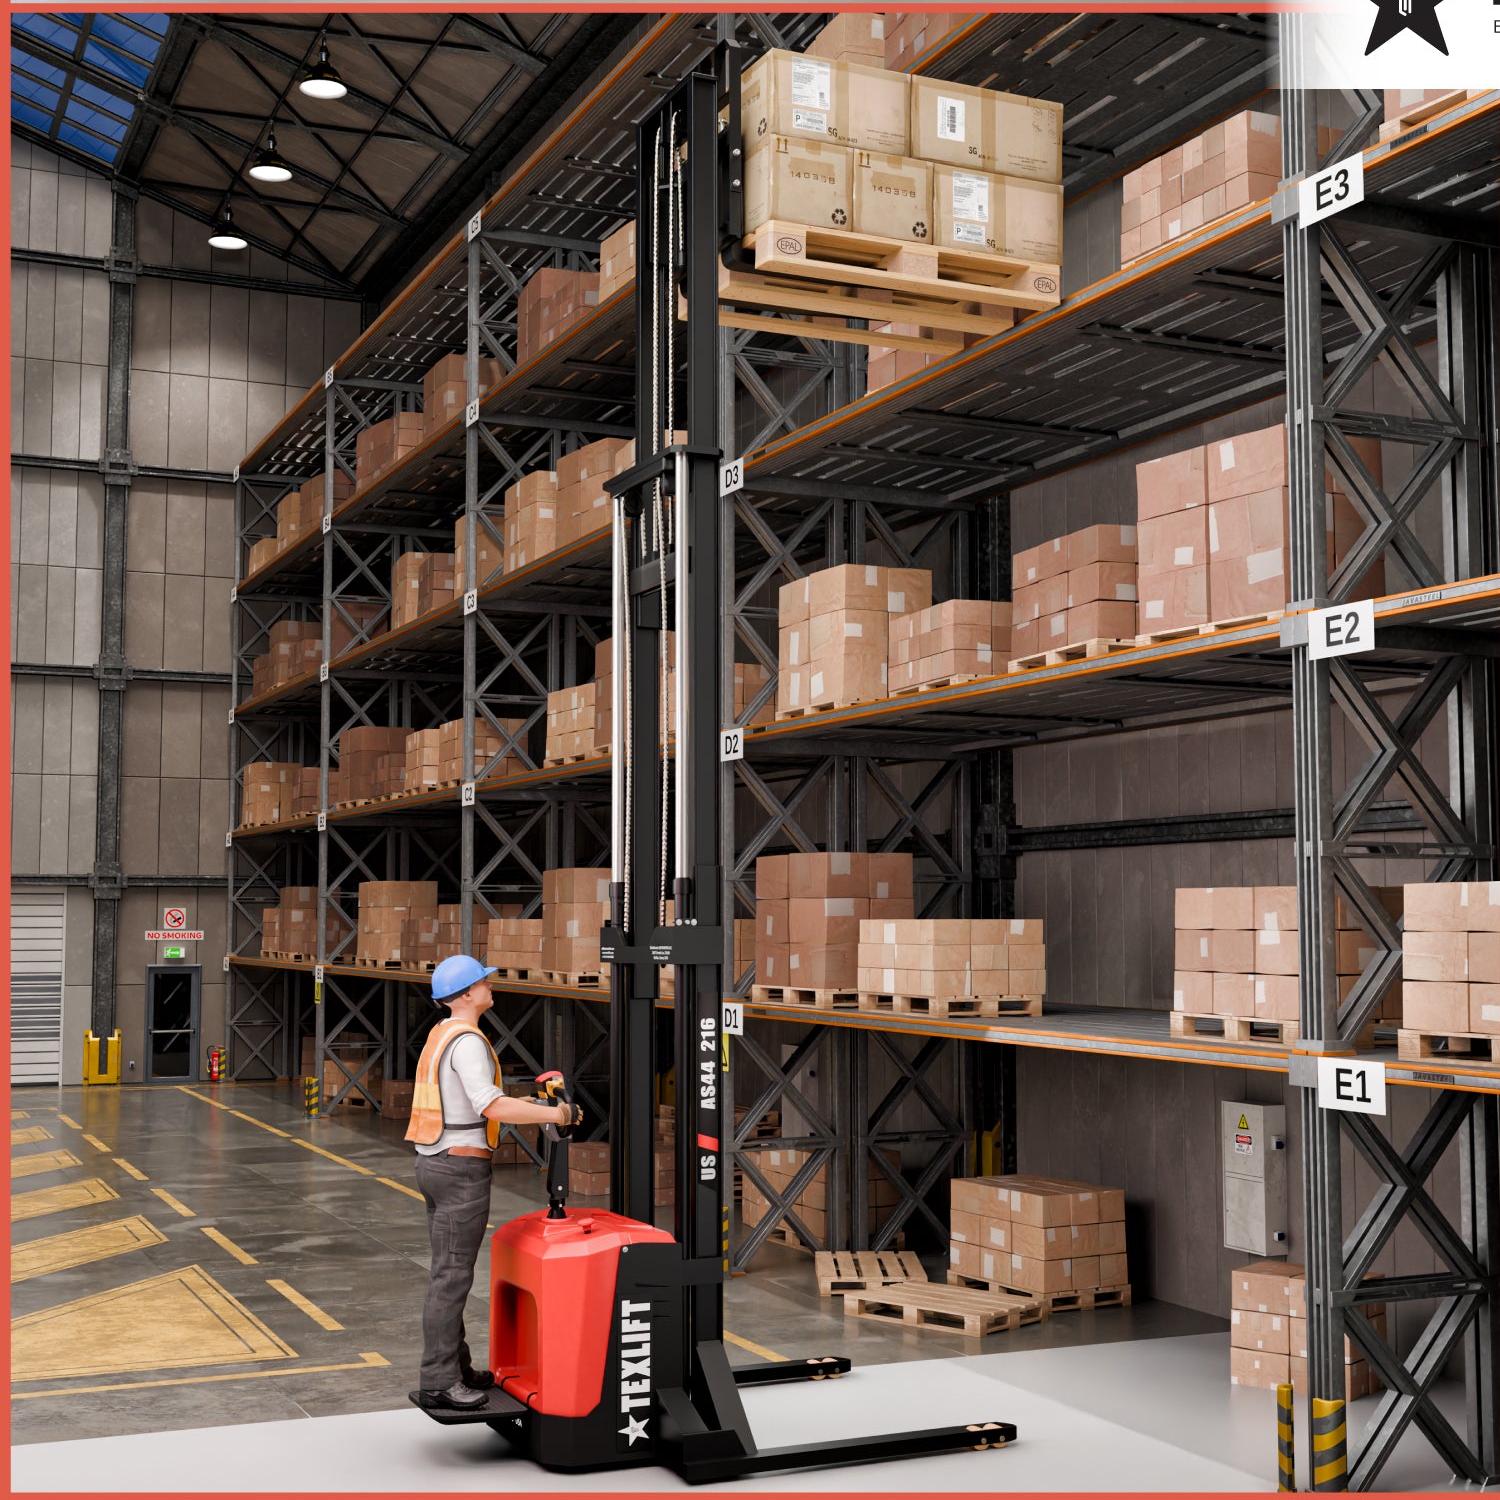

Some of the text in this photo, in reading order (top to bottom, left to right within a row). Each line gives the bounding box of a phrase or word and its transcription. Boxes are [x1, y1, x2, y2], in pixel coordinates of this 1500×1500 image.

[795, 114, 801, 122] P
[828, 126, 838, 138] SG
[968, 146, 978, 156] SG
[1316, 168, 1349, 211] E3
[471, 216, 480, 234] C5
[956, 227, 962, 235] P
[780, 240, 799, 252] EPAL
[986, 238, 996, 250] SG
[1036, 279, 1053, 292] EPAL
[468, 405, 478, 421] C4
[725, 465, 739, 489] D3
[466, 595, 475, 610] C3
[1402, 591, 1441, 606] JAVASTEEL
[1325, 611, 1360, 647] E2
[724, 733, 738, 755] D2
[464, 786, 473, 802] C2
[724, 1008, 739, 1029] D1
[1335, 1067, 1371, 1103] E1
[700, 1017, 717, 1181] US AS44 216
[621, 1300, 651, 1413] TEXLIFT
